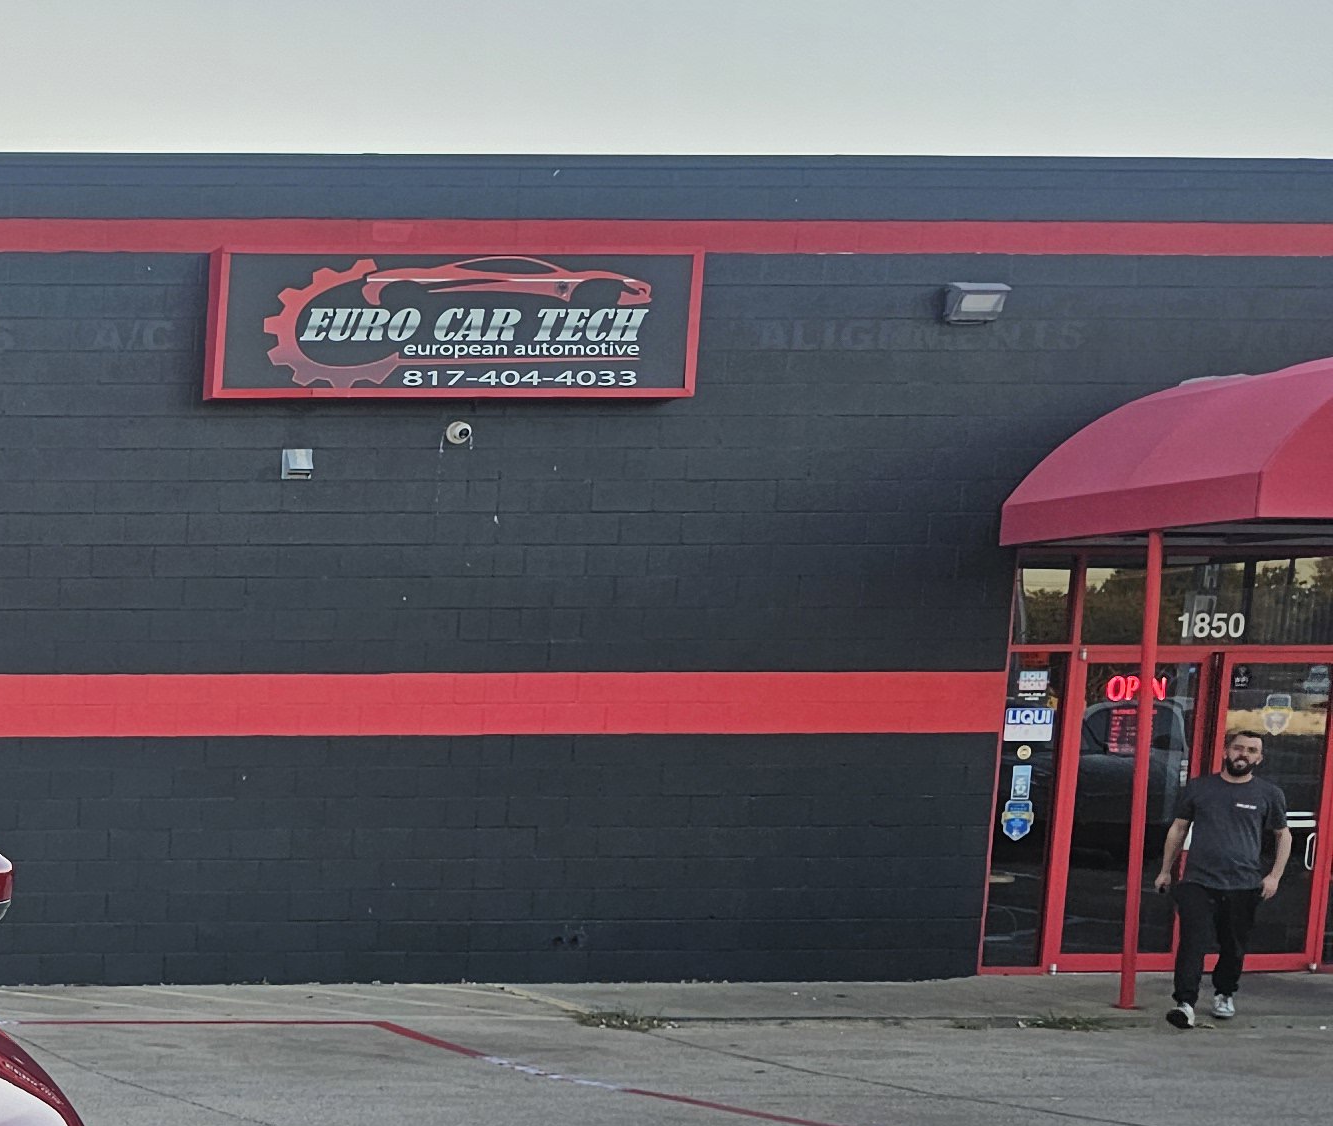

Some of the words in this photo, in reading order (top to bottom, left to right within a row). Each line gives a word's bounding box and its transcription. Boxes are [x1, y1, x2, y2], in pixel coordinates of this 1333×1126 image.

[299, 308, 421, 342] EURO
[433, 308, 522, 342] CAR
[527, 308, 649, 342] TECH
[403, 343, 509, 358] european
[514, 341, 640, 356] automotive
[402, 370, 638, 386] 817-404-4033
[1178, 612, 1245, 638] 1850
[1106, 675, 1167, 702] OPN
[1007, 708, 1052, 725] LIQUI
